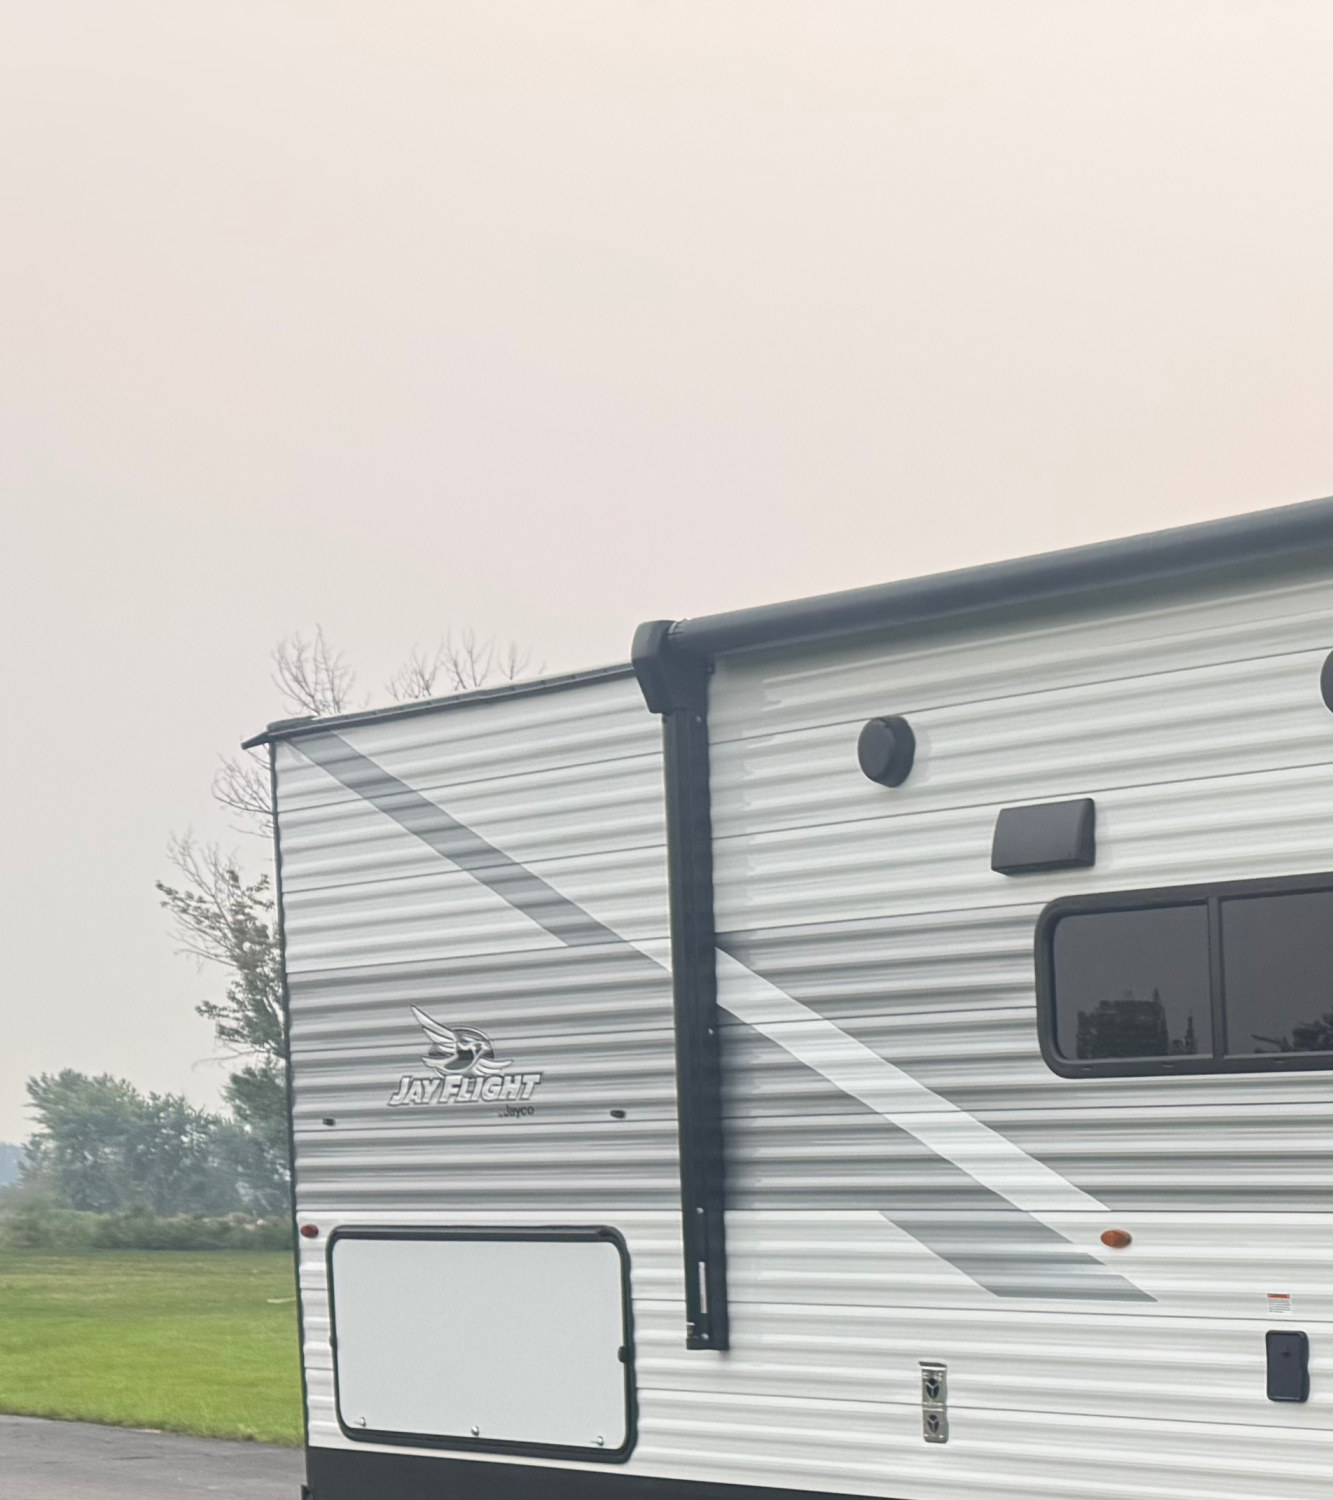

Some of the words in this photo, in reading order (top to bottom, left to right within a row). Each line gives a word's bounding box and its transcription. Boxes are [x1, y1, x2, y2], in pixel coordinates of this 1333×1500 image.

[388, 1075, 440, 1106] JAY
[437, 1072, 543, 1103] FLIGHT
[503, 1104, 535, 1118] Jayco
